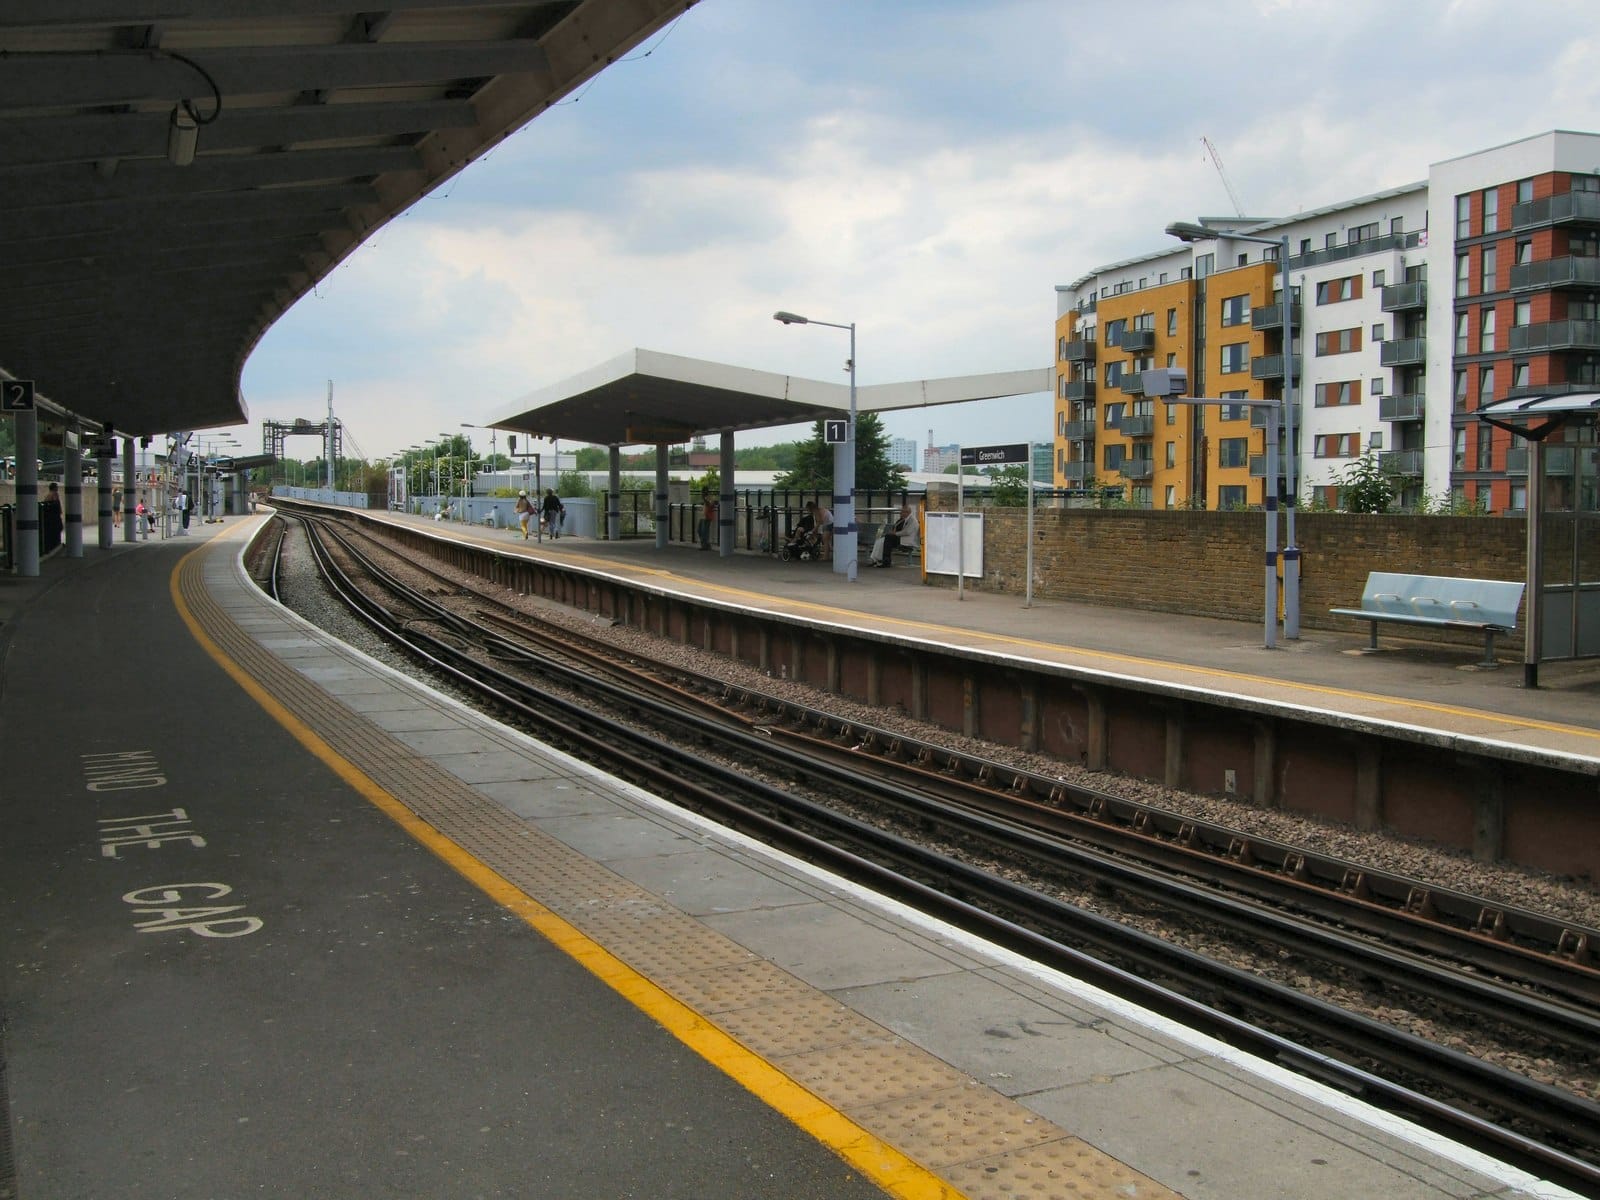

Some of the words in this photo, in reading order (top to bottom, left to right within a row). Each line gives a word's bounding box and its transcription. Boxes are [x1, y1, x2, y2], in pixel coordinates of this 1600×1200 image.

[11, 385, 25, 406] 2
[831, 423, 838, 440] 1
[979, 449, 1005, 461] Greenwich
[80, 750, 167, 791] MIND
[96, 807, 207, 857] THE
[122, 882, 264, 938] GAP
